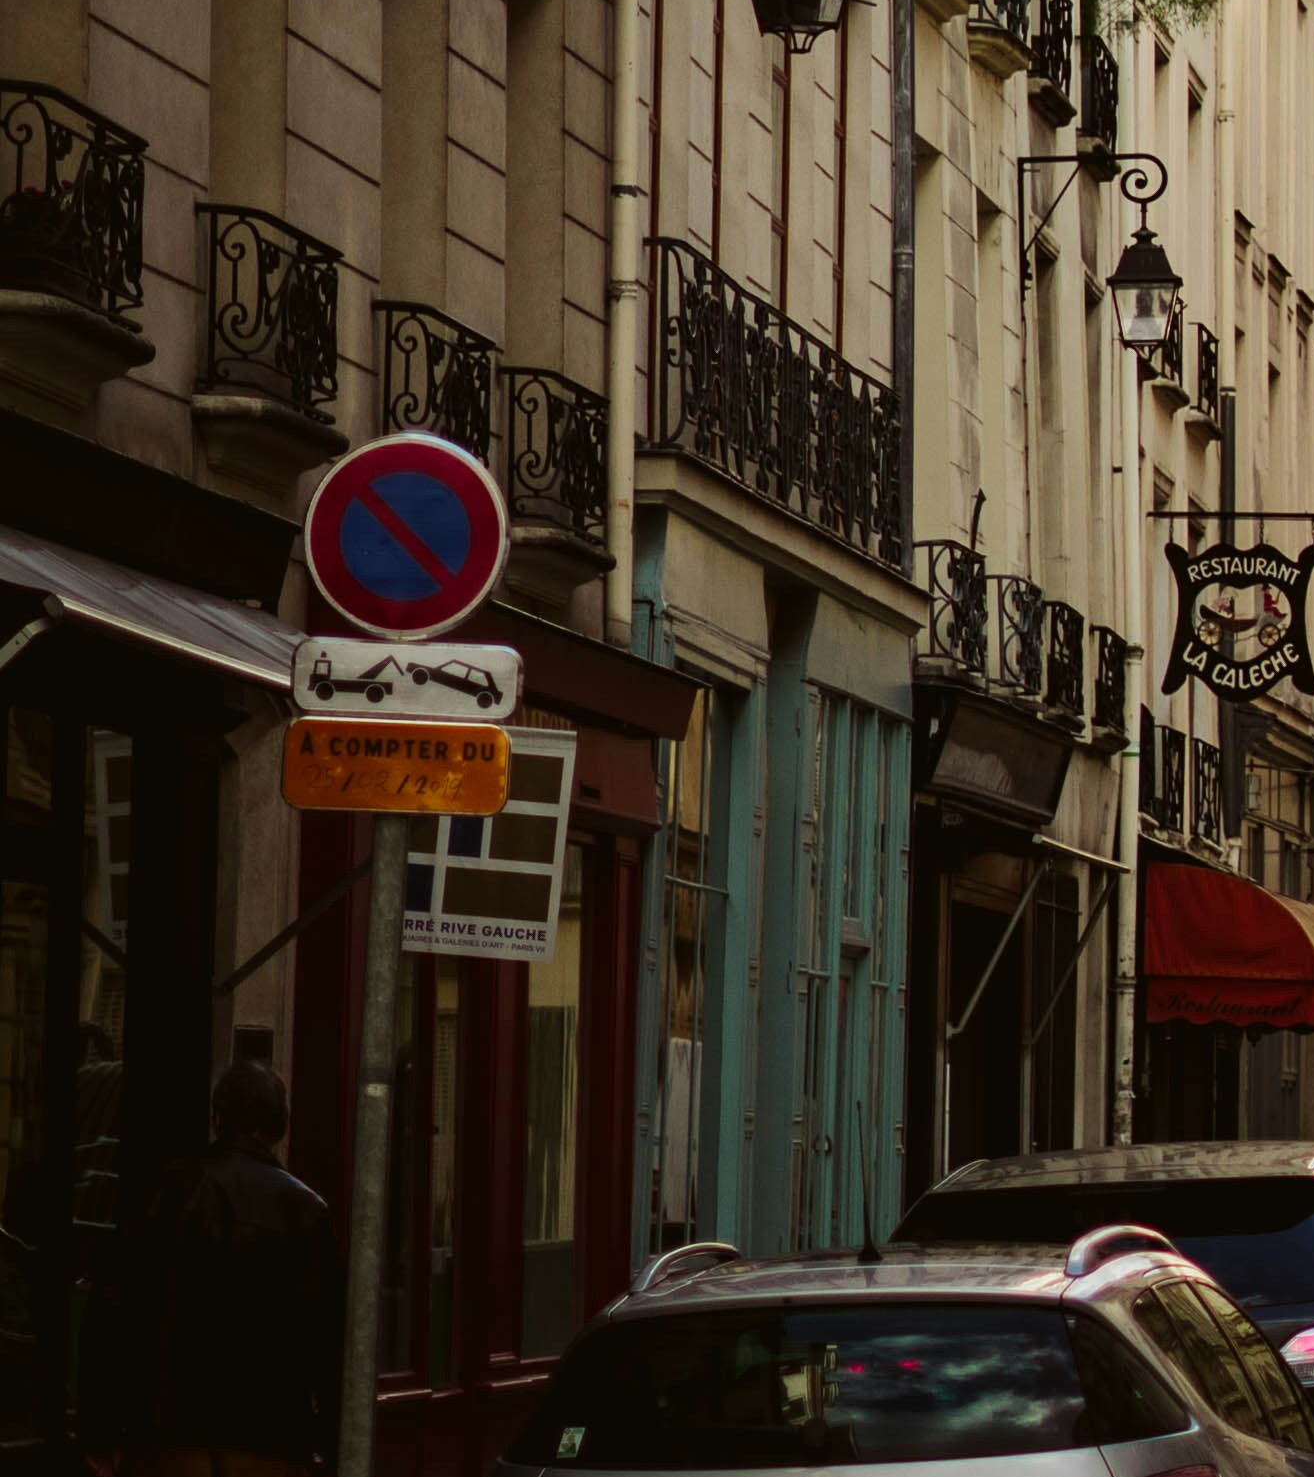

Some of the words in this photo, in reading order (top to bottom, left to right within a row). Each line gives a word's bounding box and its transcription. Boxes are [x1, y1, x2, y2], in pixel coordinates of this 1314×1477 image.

[1187, 557, 1301, 586] RESTAURANT
[1182, 641, 1208, 672] LA
[1211, 643, 1300, 690] CALECHE
[329, 736, 449, 761] COMPTER
[463, 741, 495, 762] DU
[441, 922, 477, 935] RIVE
[482, 925, 547, 942] GAUCHE
[442, 938, 479, 948] GALERIES
[511, 943, 534, 952] PARIS
